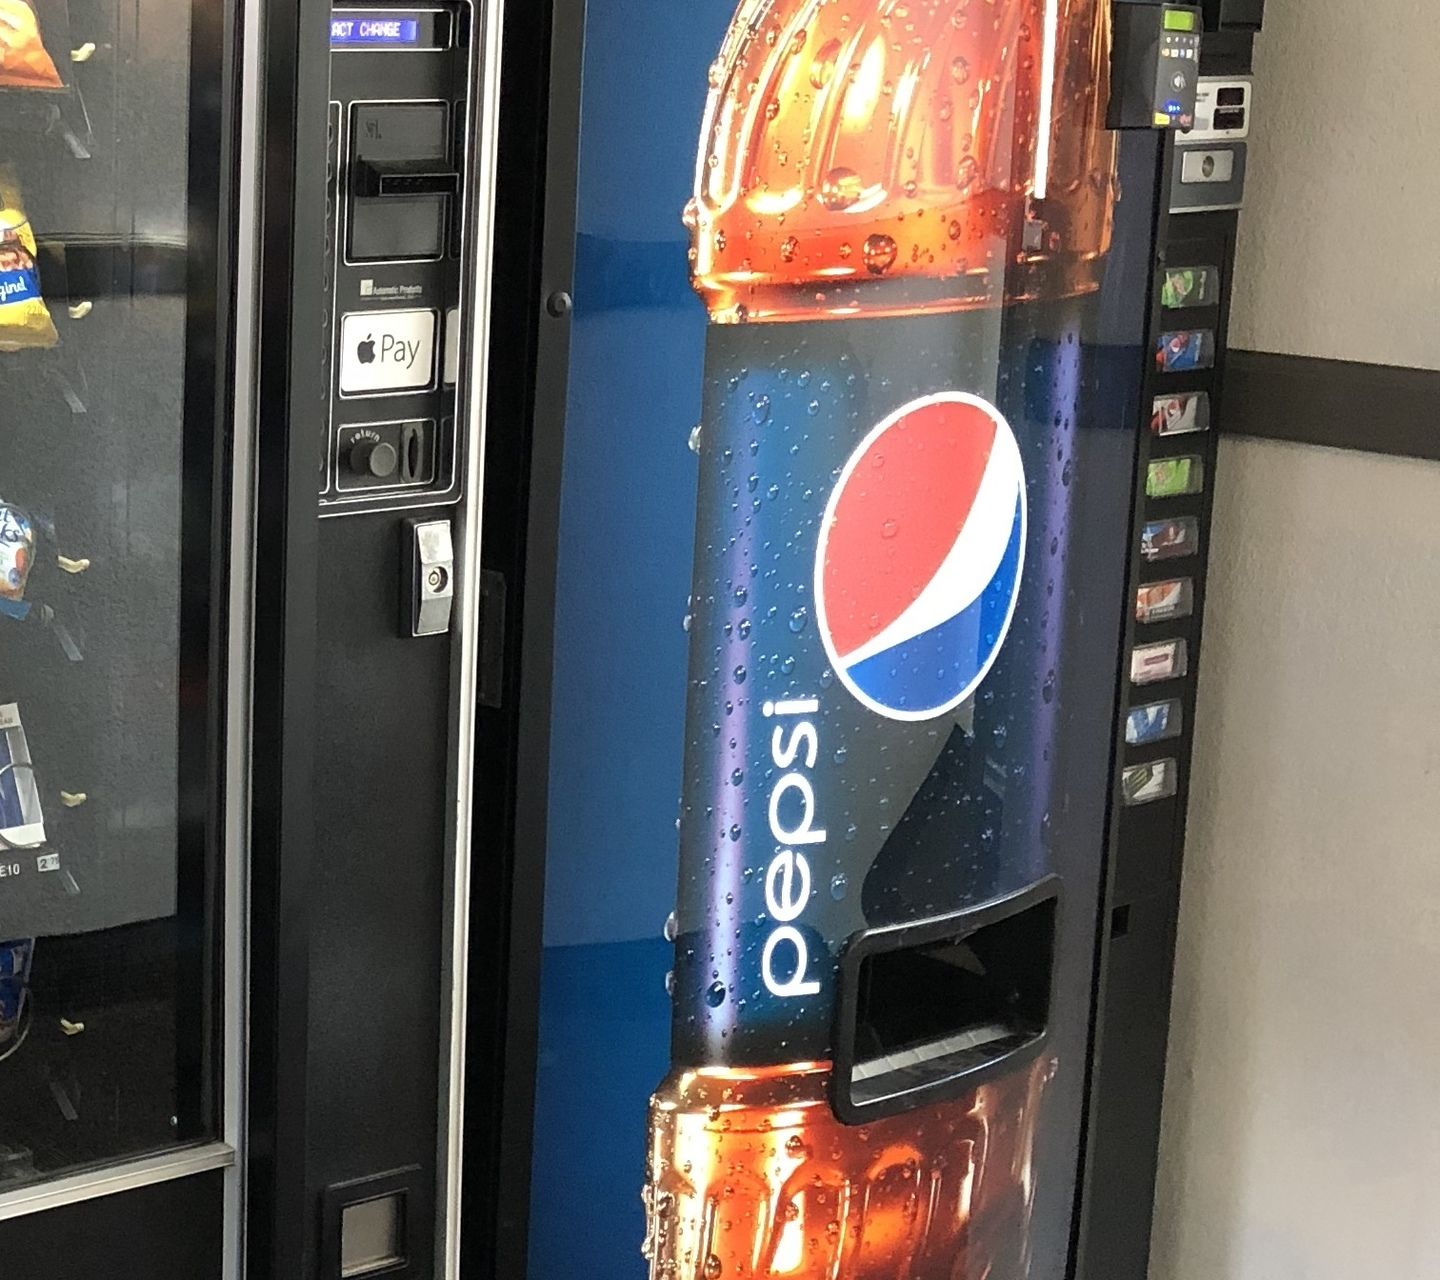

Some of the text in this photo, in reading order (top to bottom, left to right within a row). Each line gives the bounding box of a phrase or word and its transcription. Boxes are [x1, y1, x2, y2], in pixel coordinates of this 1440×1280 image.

[359, 21, 401, 37] CHANGE
[381, 334, 420, 370] Pay
[349, 428, 381, 444] return
[762, 698, 826, 997] pepsi
